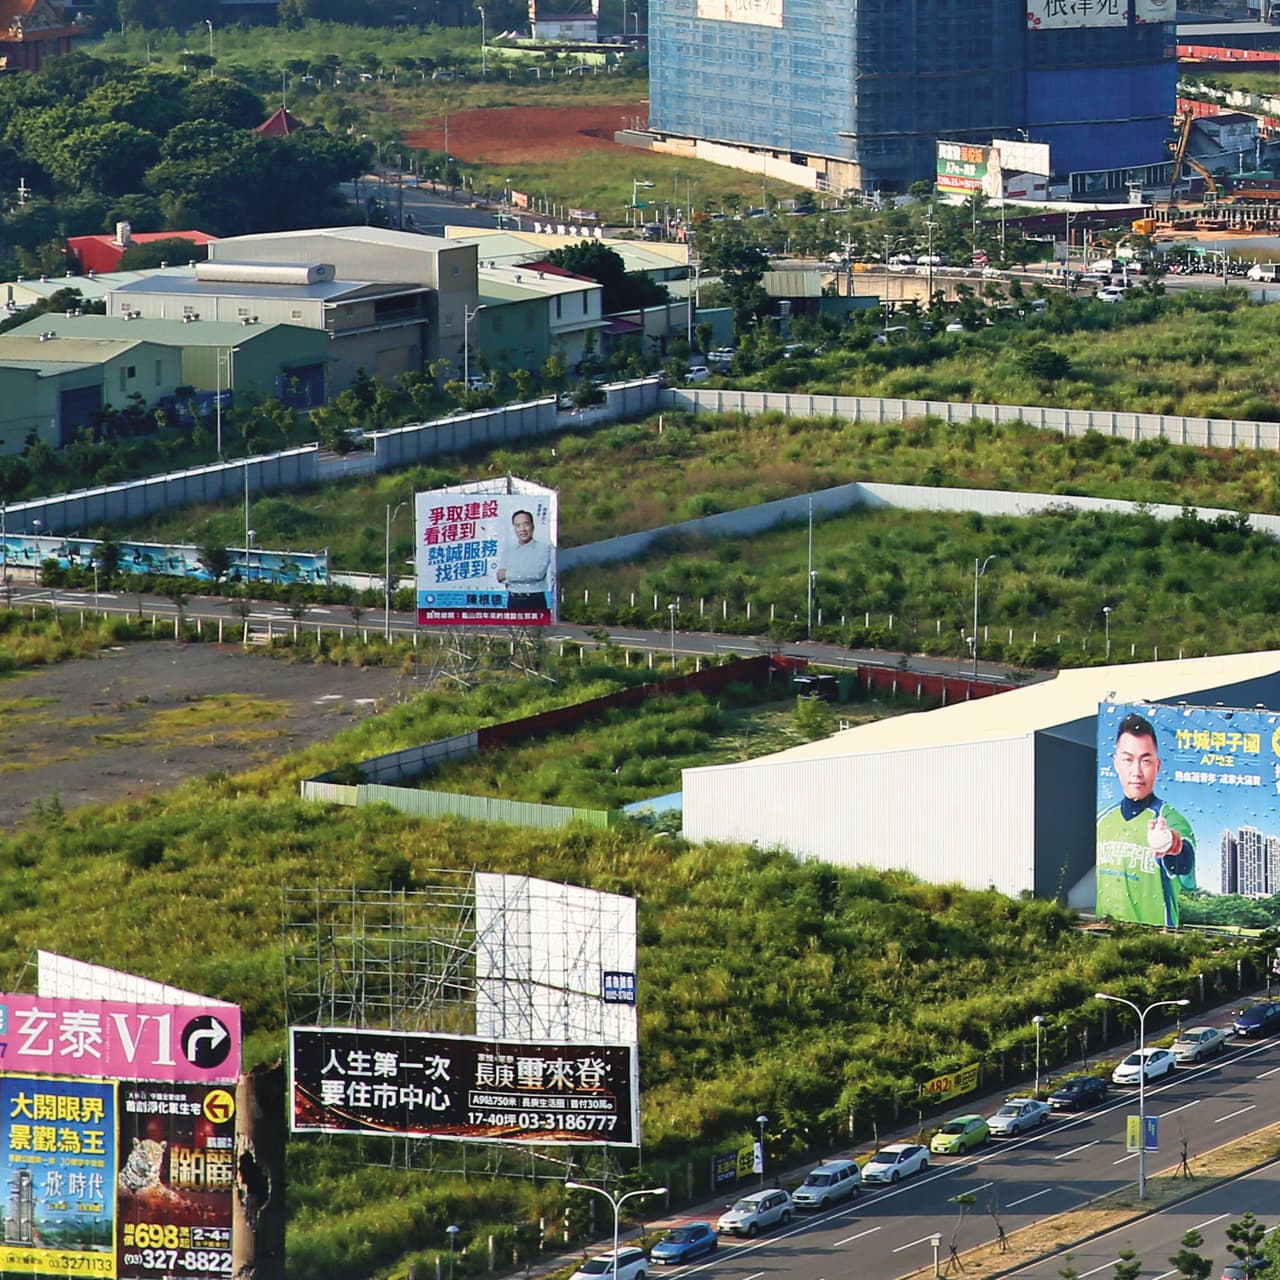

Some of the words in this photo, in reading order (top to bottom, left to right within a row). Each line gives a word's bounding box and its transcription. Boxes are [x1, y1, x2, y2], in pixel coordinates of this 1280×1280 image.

[428, 499, 498, 525] 爭取建設
[428, 539, 498, 565] 熱誠服務
[1175, 729, 1261, 754] 竹城甲子園
[1200, 754, 1234, 767] A7地王
[15, 1007, 102, 1059] 玄泰
[109, 1012, 176, 1066] V1
[320, 1048, 450, 1081] 人生第一次
[10, 1092, 105, 1124] 大開眼界
[320, 1080, 450, 1111] 要住市中心
[468, 1112, 517, 1127] 17-40坪
[518, 1112, 617, 1131] 03-3186777
[9, 1124, 106, 1155] 景觀為王
